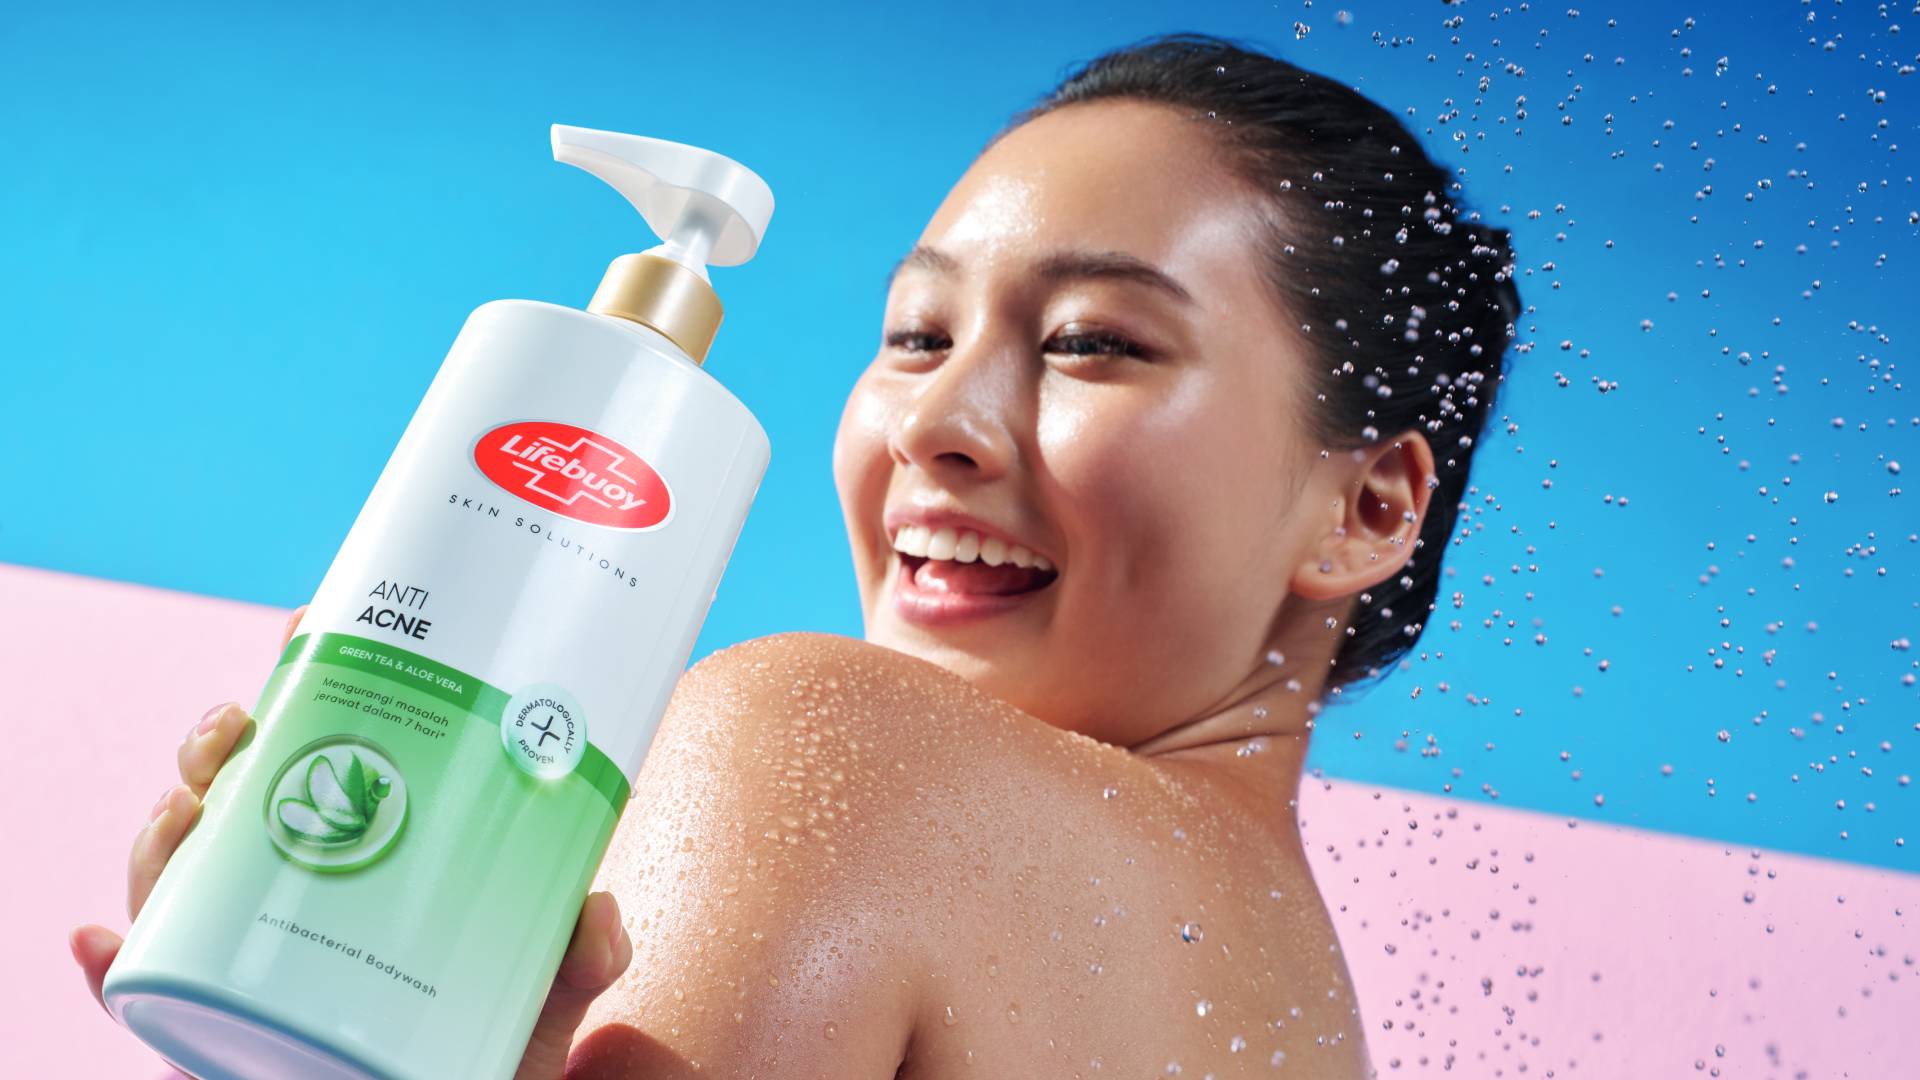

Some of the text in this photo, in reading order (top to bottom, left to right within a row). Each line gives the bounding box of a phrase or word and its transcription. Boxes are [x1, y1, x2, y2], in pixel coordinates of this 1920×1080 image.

[499, 434, 647, 510] Lifebuoy
[449, 494, 637, 587] SKIN SOLUTIONS
[369, 580, 430, 610] ANTI
[356, 606, 432, 640] ACNE
[339, 646, 463, 694] GREEN TEA & ALOE VERA
[313, 690, 361, 711] jerawat
[362, 702, 403, 727] dalam
[405, 717, 413, 728] 7
[322, 677, 450, 728] Mengurangi masalah
[516, 698, 575, 754] DERMATOLOGICALLY
[518, 738, 554, 764] PROVEN
[258, 912, 438, 998] Antibacterial Bodywash
